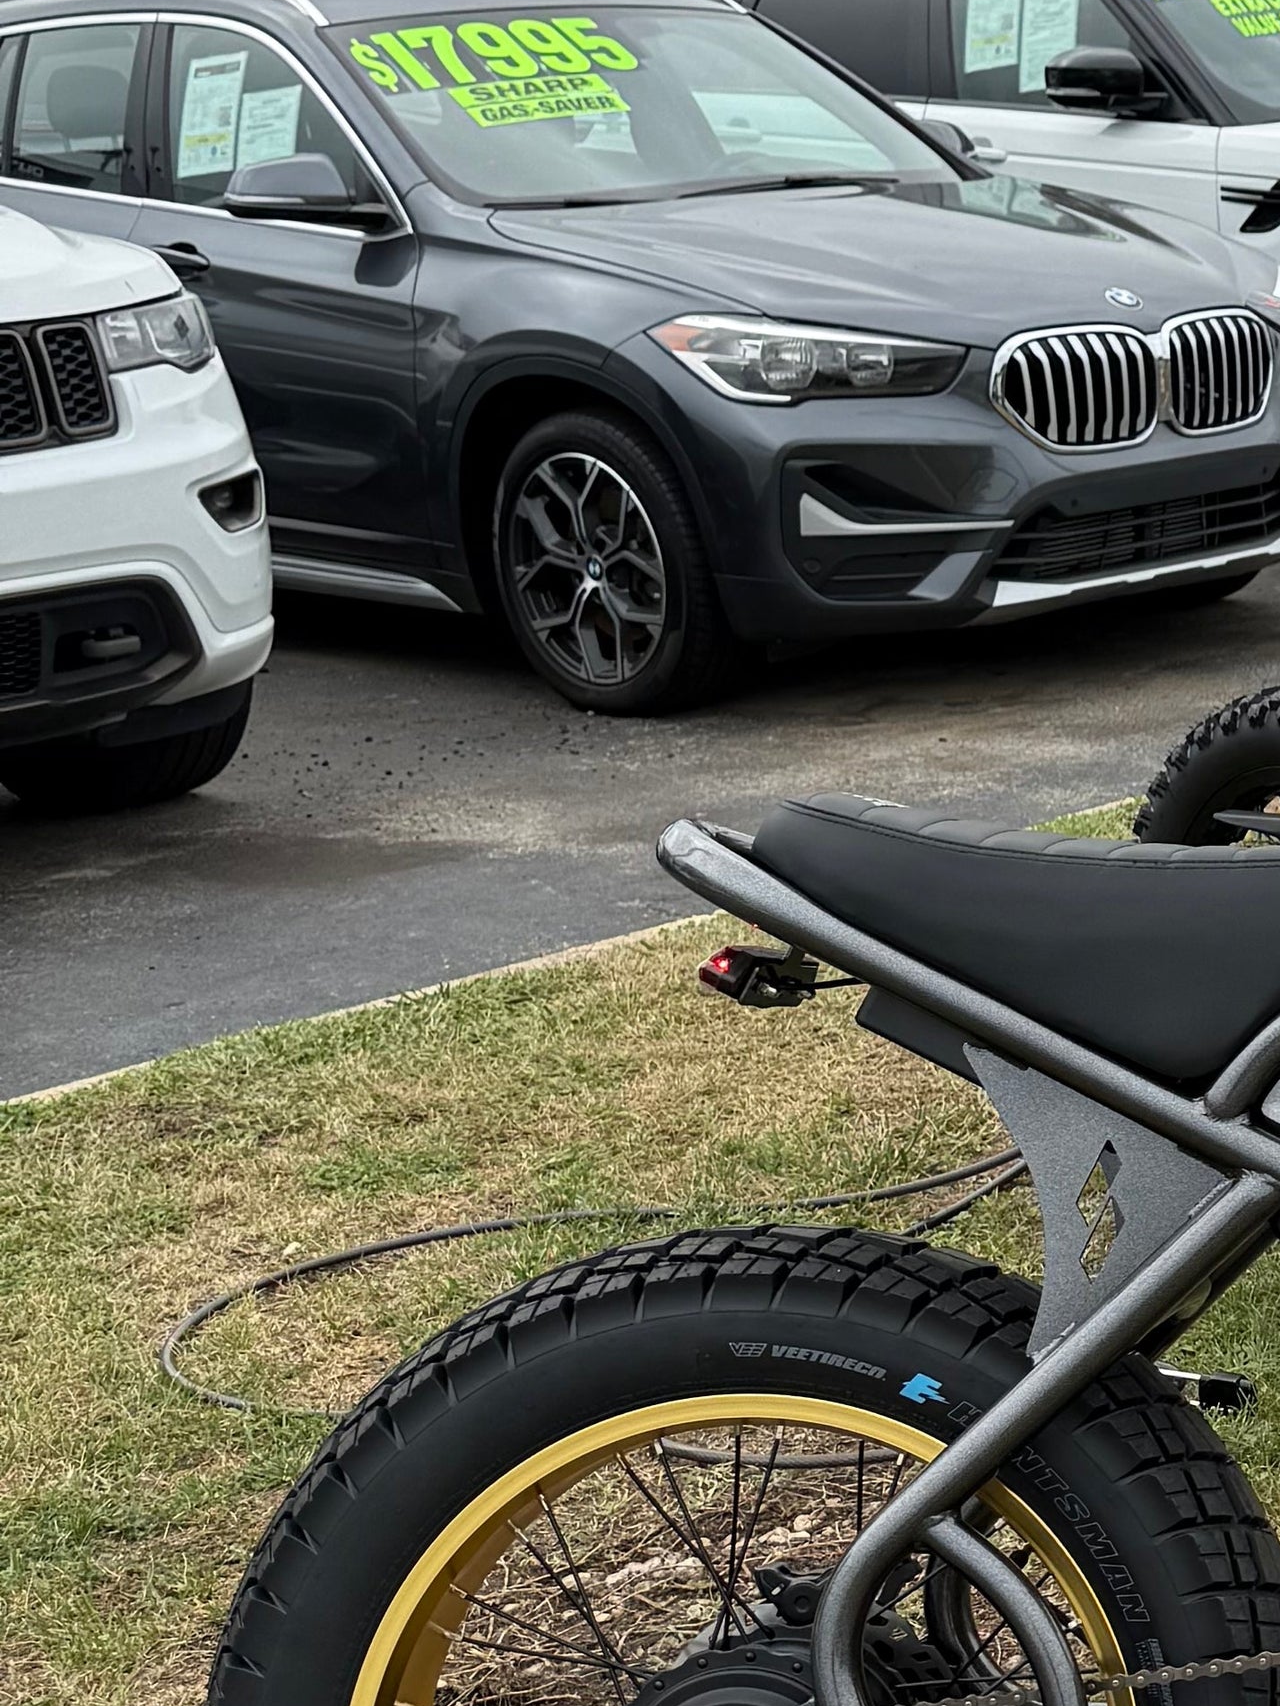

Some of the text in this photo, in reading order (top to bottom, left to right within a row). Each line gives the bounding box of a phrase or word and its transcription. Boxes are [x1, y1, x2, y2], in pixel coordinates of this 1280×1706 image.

[350, 17, 639, 93] $17995
[468, 76, 594, 102] SHARP
[948, 1401, 1150, 1622] HNTSMAN
